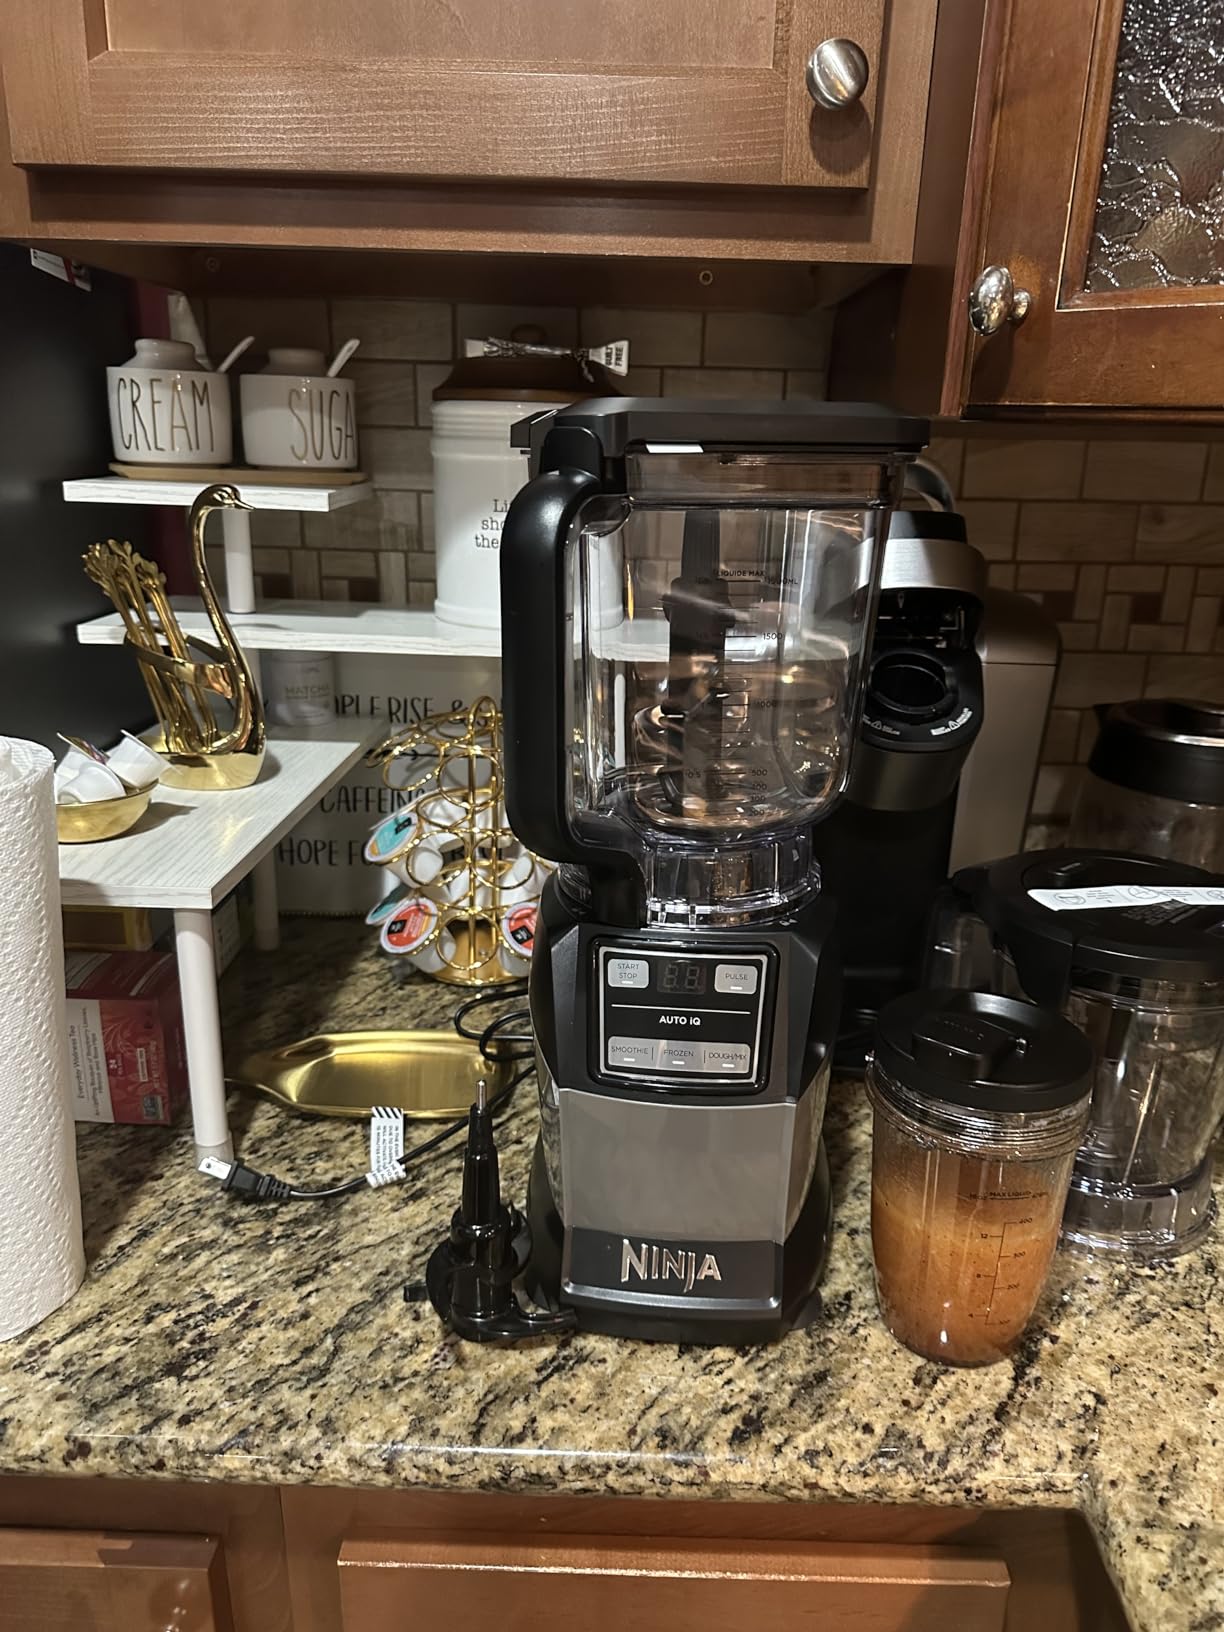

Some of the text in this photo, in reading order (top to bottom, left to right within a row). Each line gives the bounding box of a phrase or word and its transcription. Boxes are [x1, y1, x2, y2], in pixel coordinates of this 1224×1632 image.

[615, 346, 624, 367] FREE
[117, 377, 215, 453] CREAM
[287, 388, 357, 462] SUGA
[493, 498, 508, 513] Li
[475, 534, 499, 549] the
[762, 632, 783, 640] 1500
[388, 696, 434, 724] RISE
[320, 786, 426, 813] CAFFEIN
[280, 838, 338, 866] HOPE
[725, 973, 749, 981] PULSE
[659, 1015, 687, 1025] AUTO
[71, 1038, 80, 1068] Wellness
[611, 1045, 649, 1055] SMOOTHIE
[664, 1049, 694, 1057] FROZEN
[708, 1052, 747, 1061] DOUGH/MIX
[75, 1069, 85, 1098] Everyday
[621, 1238, 722, 1293] NINJA
